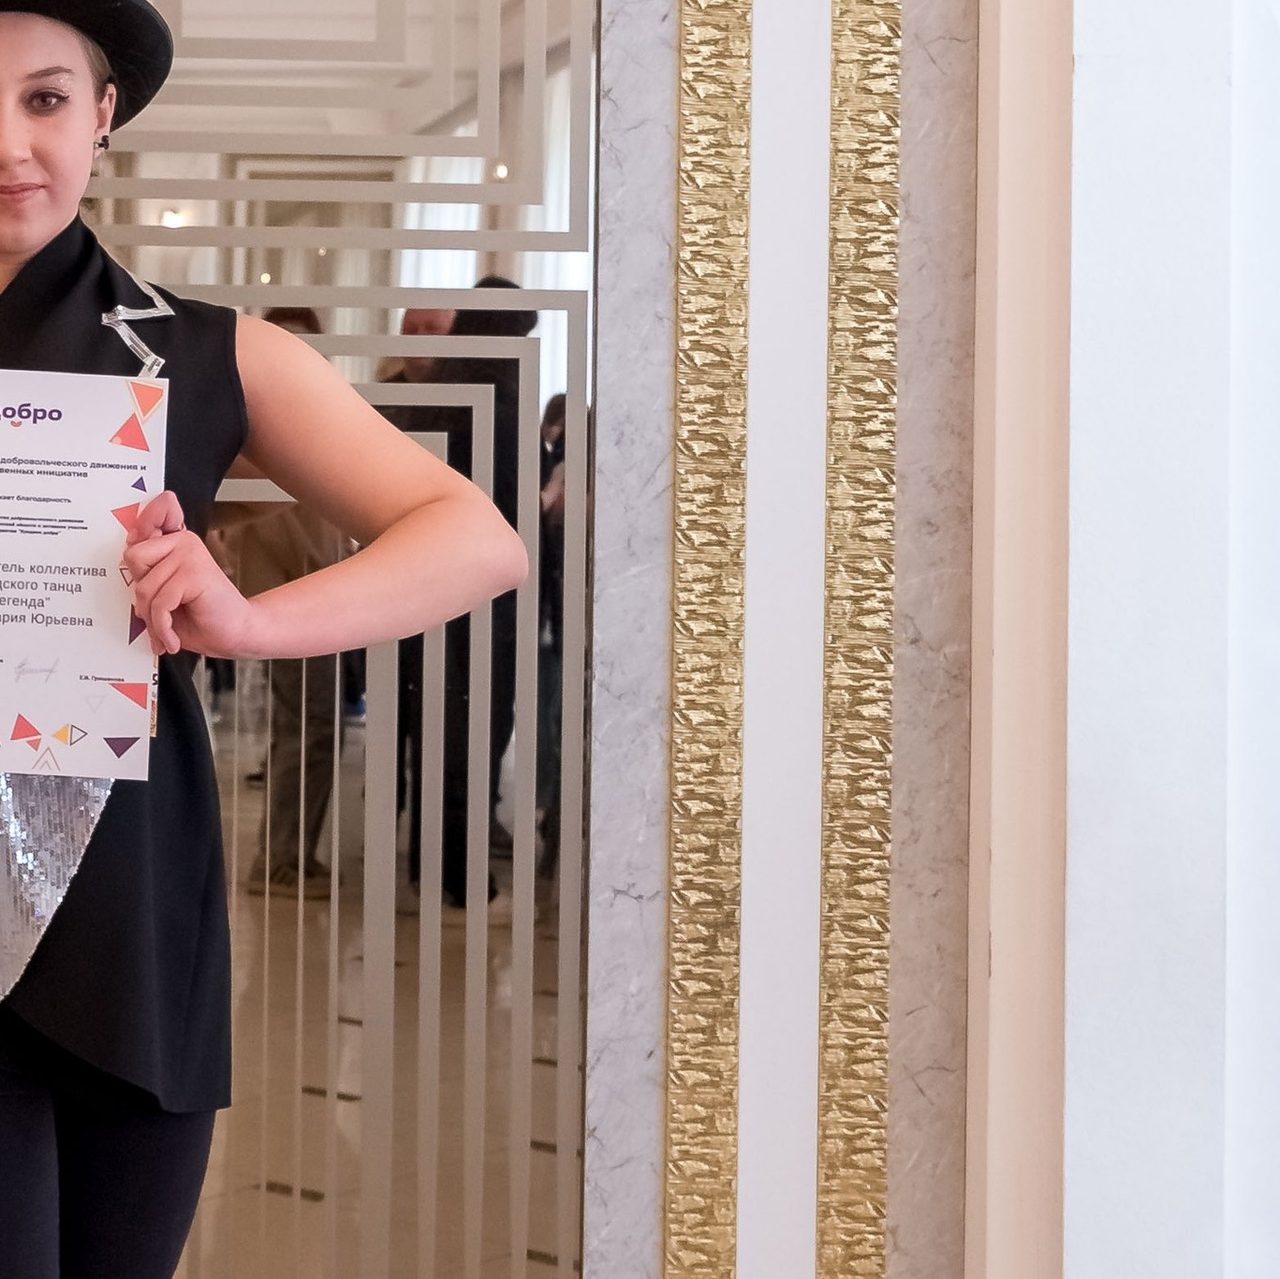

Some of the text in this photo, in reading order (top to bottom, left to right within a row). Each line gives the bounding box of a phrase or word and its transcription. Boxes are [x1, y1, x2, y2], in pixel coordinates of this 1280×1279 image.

[0, 456, 89, 468] добровольческого
[89, 462, 139, 471] движения
[36, 469, 89, 478] инициатив
[15, 494, 72, 504] благодарность
[29, 564, 107, 578] коллектива
[42, 581, 83, 595] танца
[30, 612, 94, 628] Юрьевна
